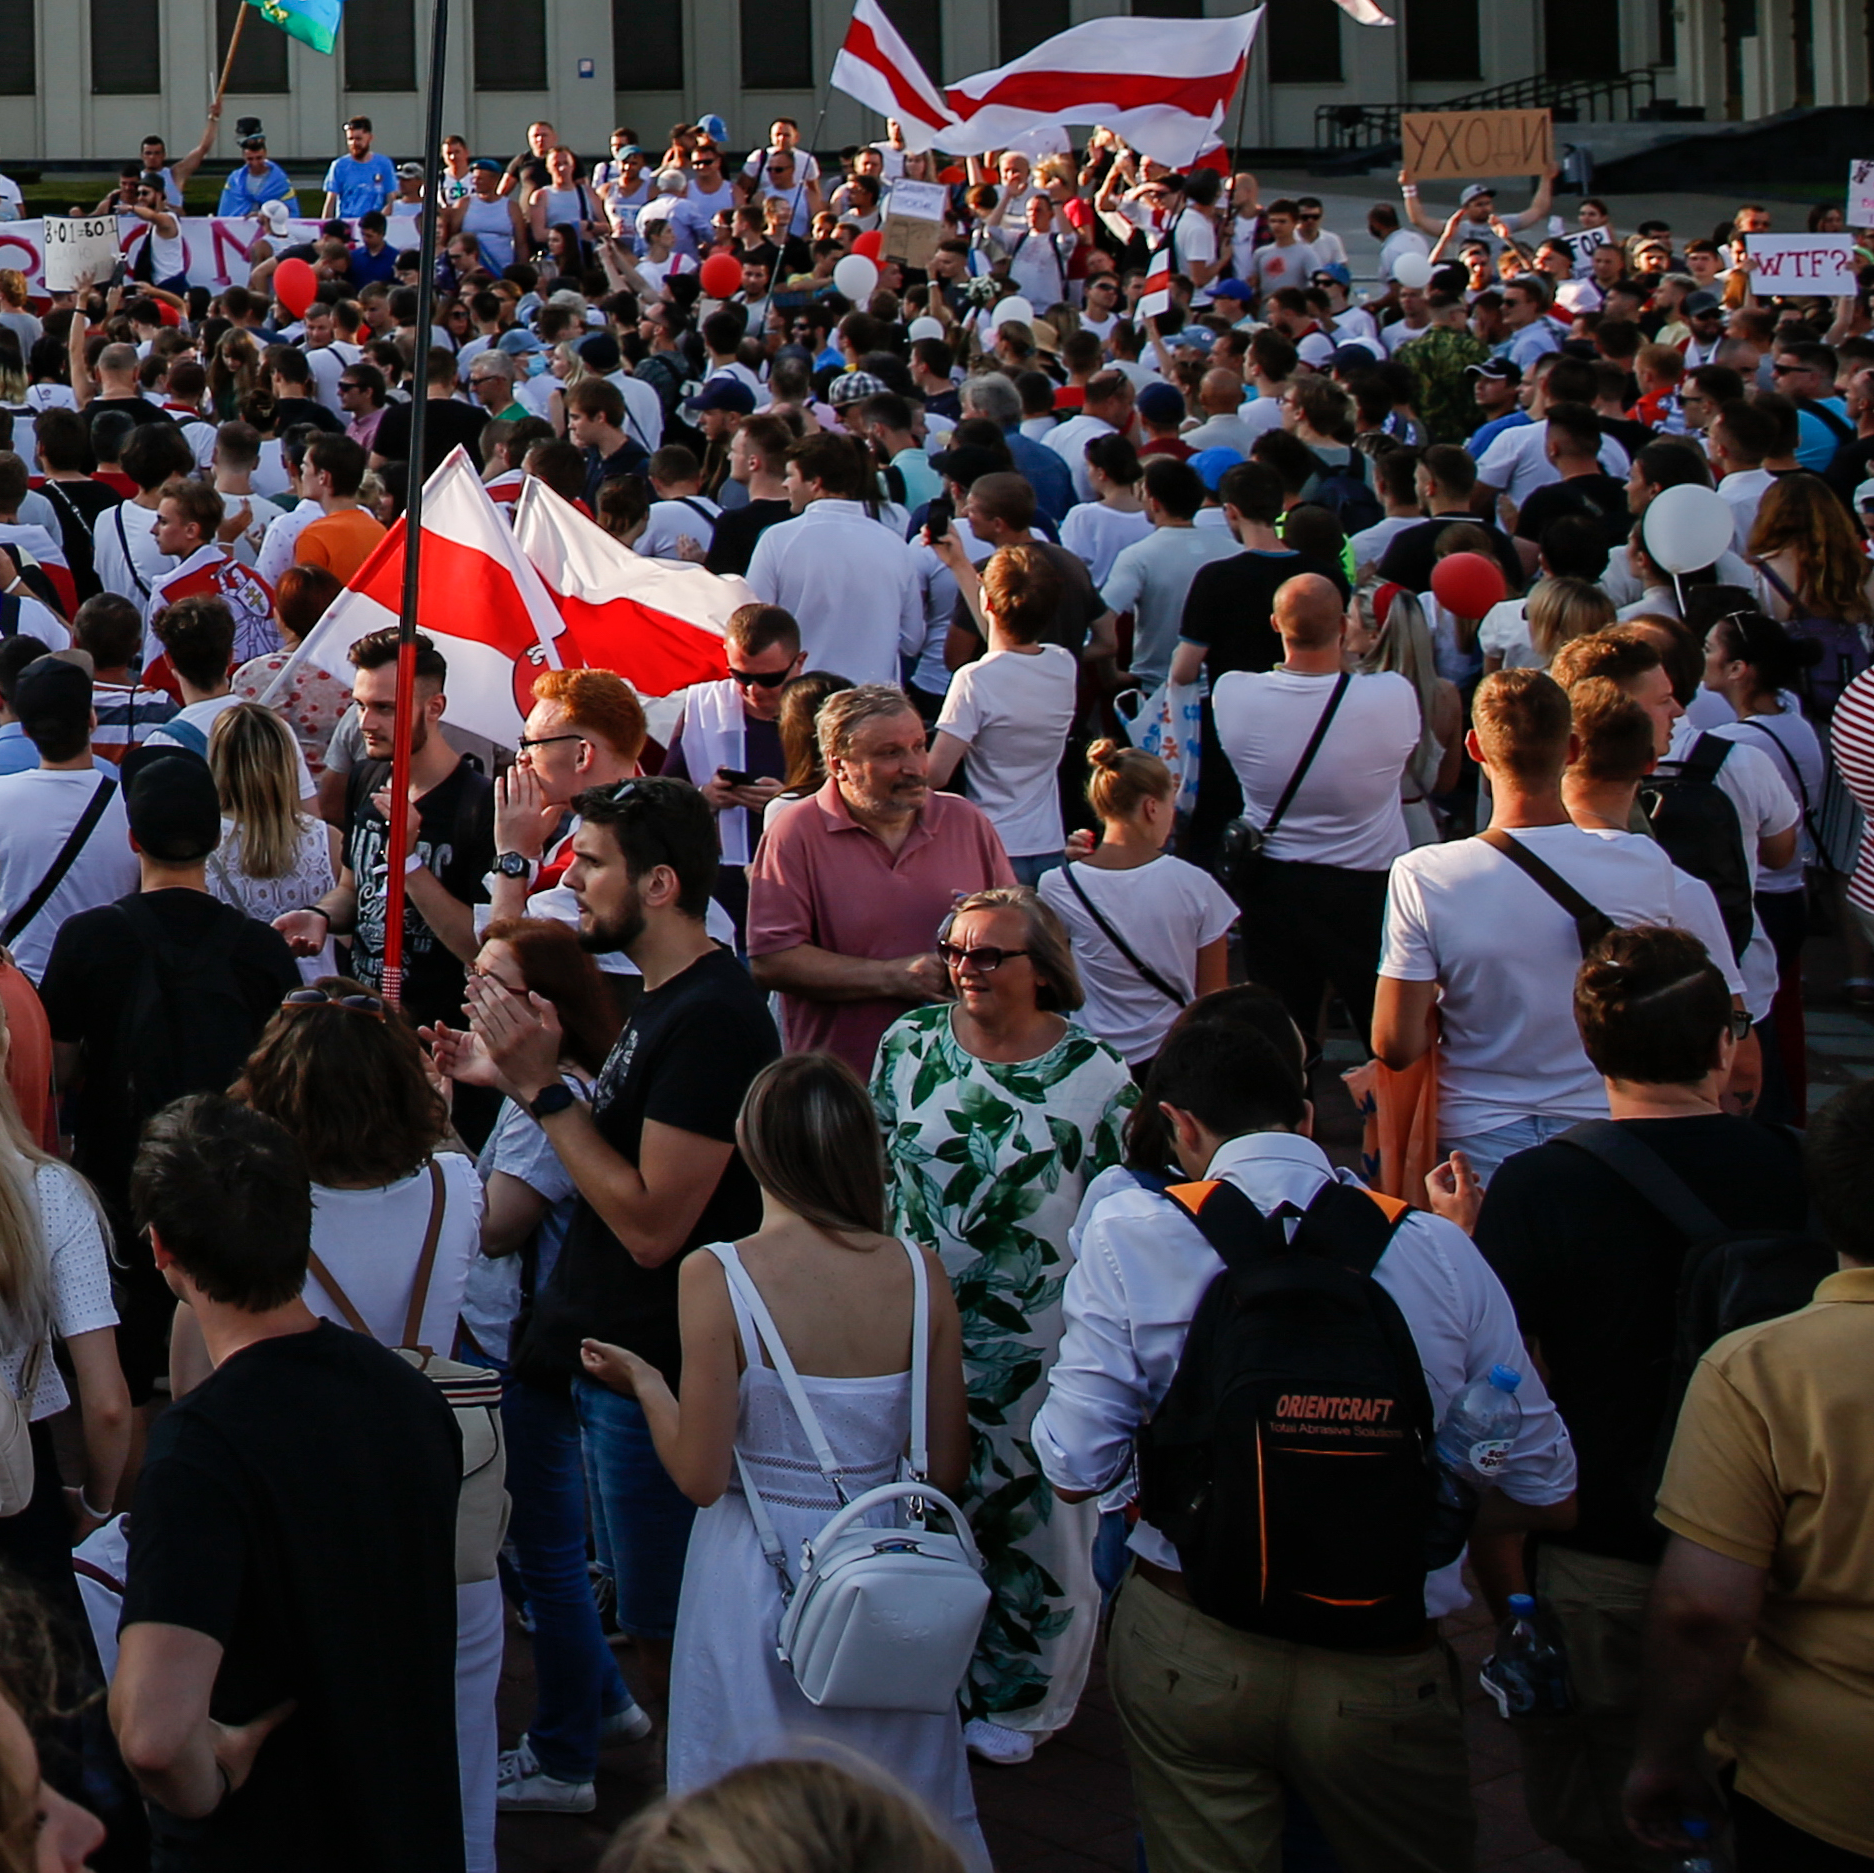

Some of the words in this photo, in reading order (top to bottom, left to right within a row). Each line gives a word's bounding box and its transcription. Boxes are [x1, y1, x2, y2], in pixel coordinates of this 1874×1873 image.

[1404, 115, 1548, 172] УХОДИ
[1754, 250, 1847, 278] WTF?
[1275, 1394, 1394, 1422] ORIENTCRAFT
[1269, 1422, 1297, 1433] Total
[1298, 1423, 1351, 1436] Abrasive
[1353, 1426, 1404, 1438] Solutions
